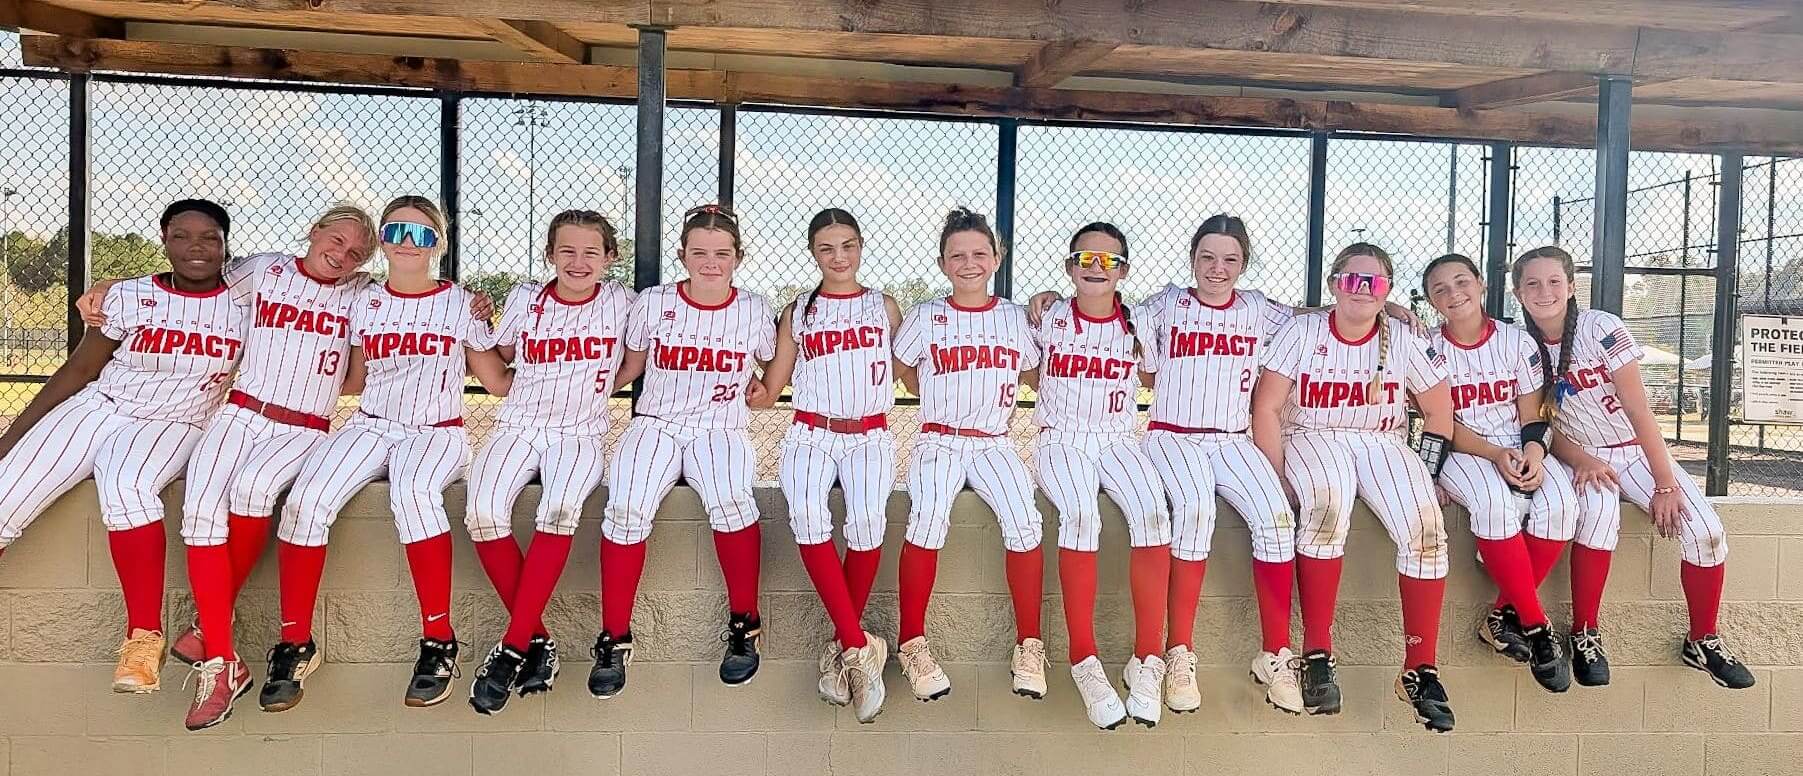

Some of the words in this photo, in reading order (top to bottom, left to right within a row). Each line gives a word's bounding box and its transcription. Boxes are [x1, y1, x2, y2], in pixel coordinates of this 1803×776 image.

[254, 291, 349, 339] IMPACT
[129, 325, 242, 361] IMPACT
[520, 331, 618, 364] IMPACT
[653, 337, 747, 373] IMPACT
[799, 325, 885, 362] IMPACT
[1169, 325, 1258, 360] IMPACT
[1750, 342, 1776, 352] THE
[1780, 343, 1803, 354] FIE
[316, 350, 341, 376] 13
[931, 343, 1020, 376] IMPACT
[1046, 345, 1135, 381] IMPACT
[200, 372, 228, 391] 15
[440, 368, 448, 392] 1
[594, 369, 610, 394] 5
[870, 361, 888, 387] 17
[999, 383, 1016, 408] 19
[1108, 390, 1127, 414] 10
[1380, 415, 1395, 431] 11
